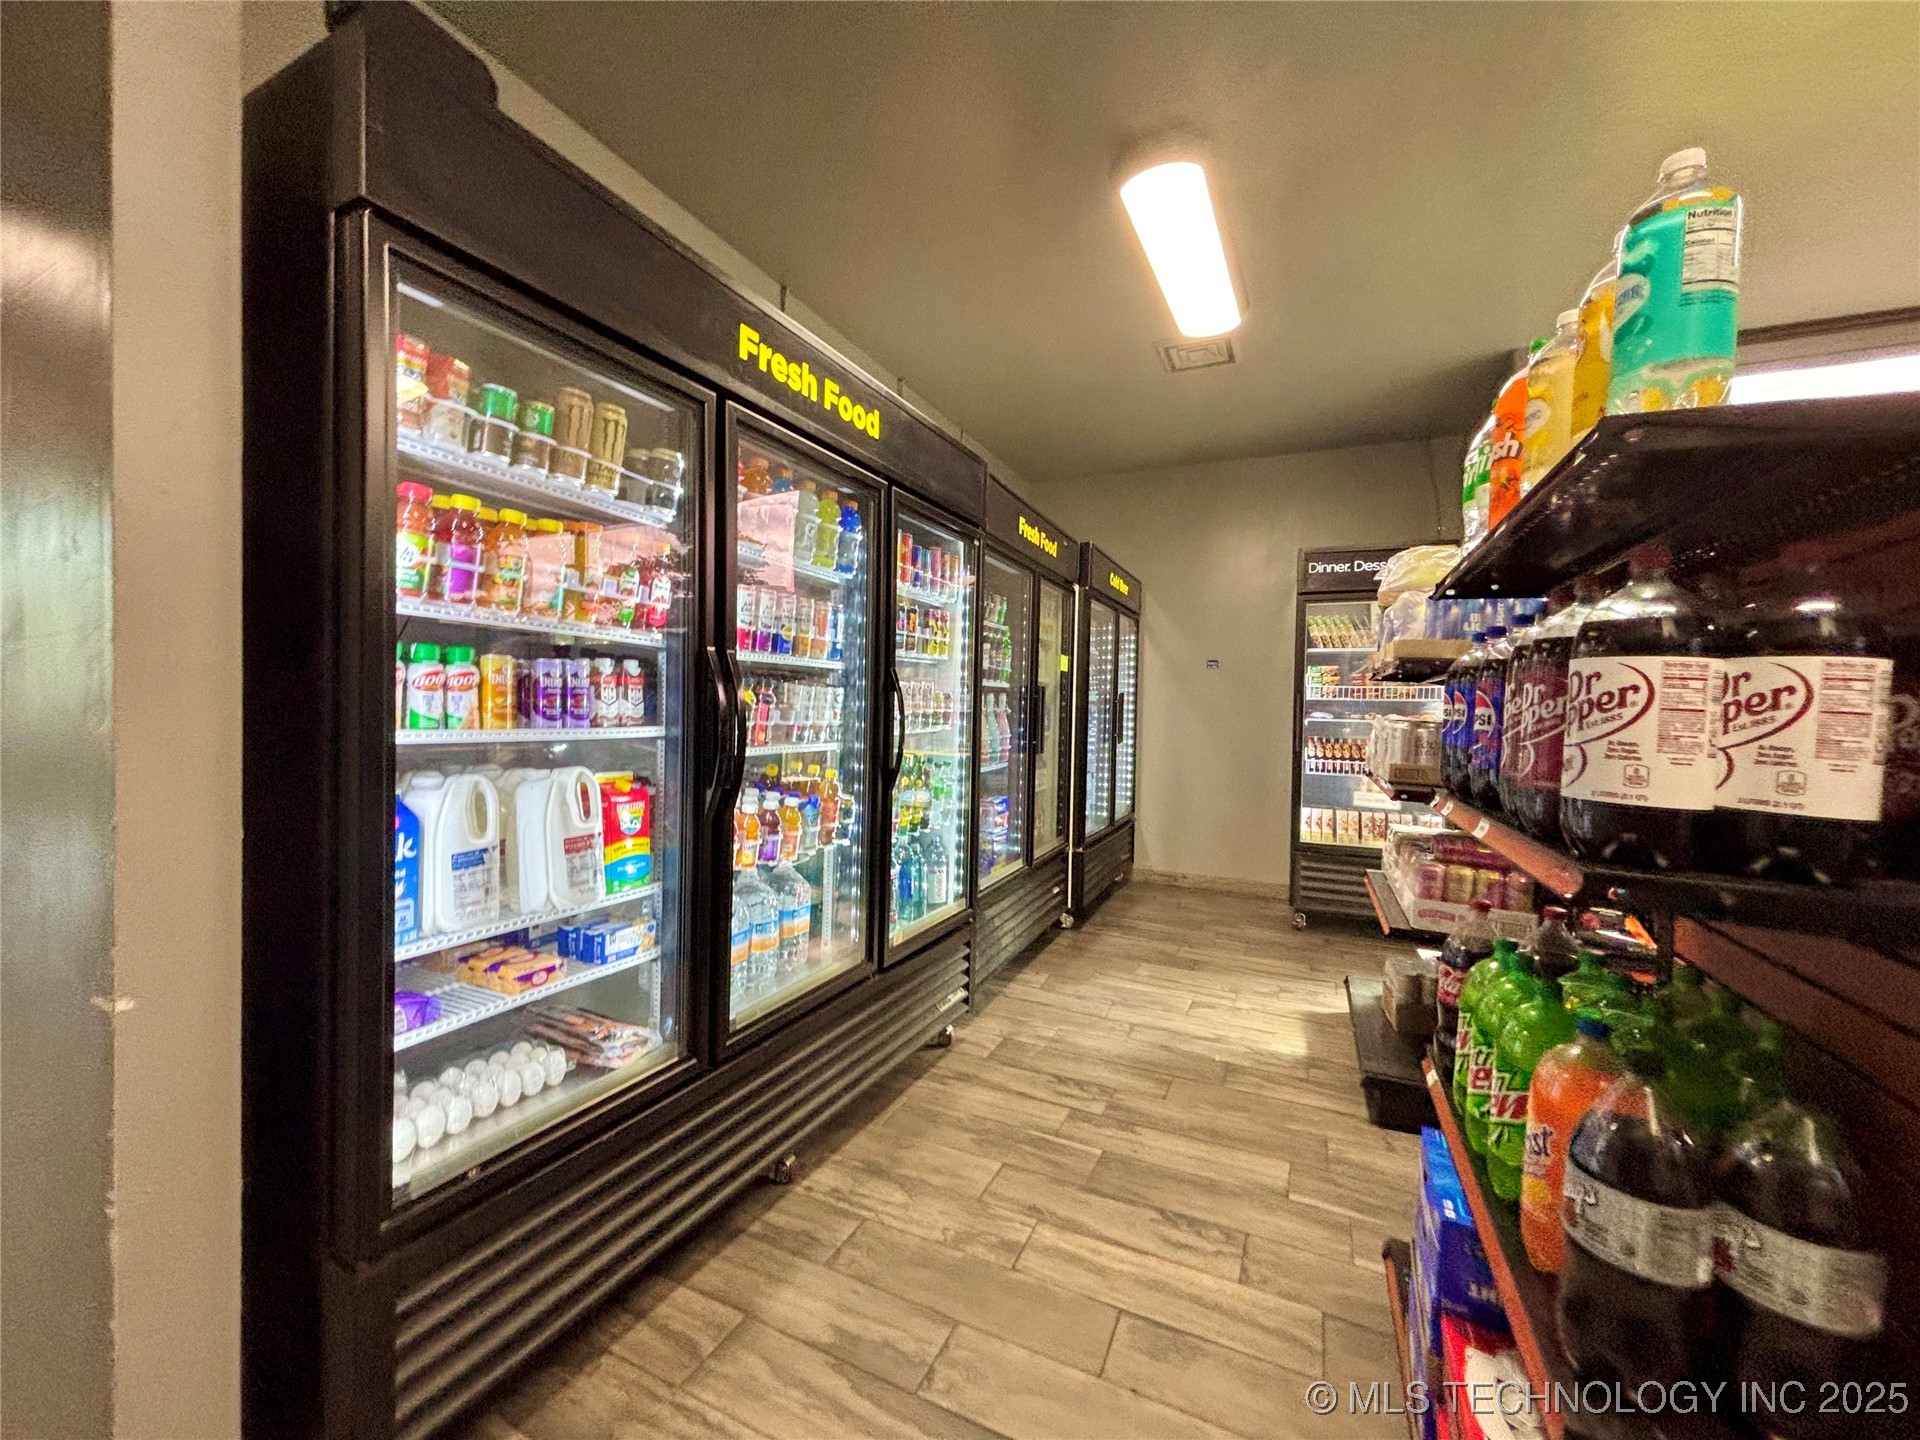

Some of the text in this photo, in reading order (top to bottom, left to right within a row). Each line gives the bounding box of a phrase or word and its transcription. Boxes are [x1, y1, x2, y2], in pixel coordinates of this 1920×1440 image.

[1687, 208, 1732, 219] Nutrition
[739, 323, 880, 440] Fresh Food
[1019, 515, 1058, 558] Fresh Food
[1308, 560, 1388, 574] Dinner. Dess
